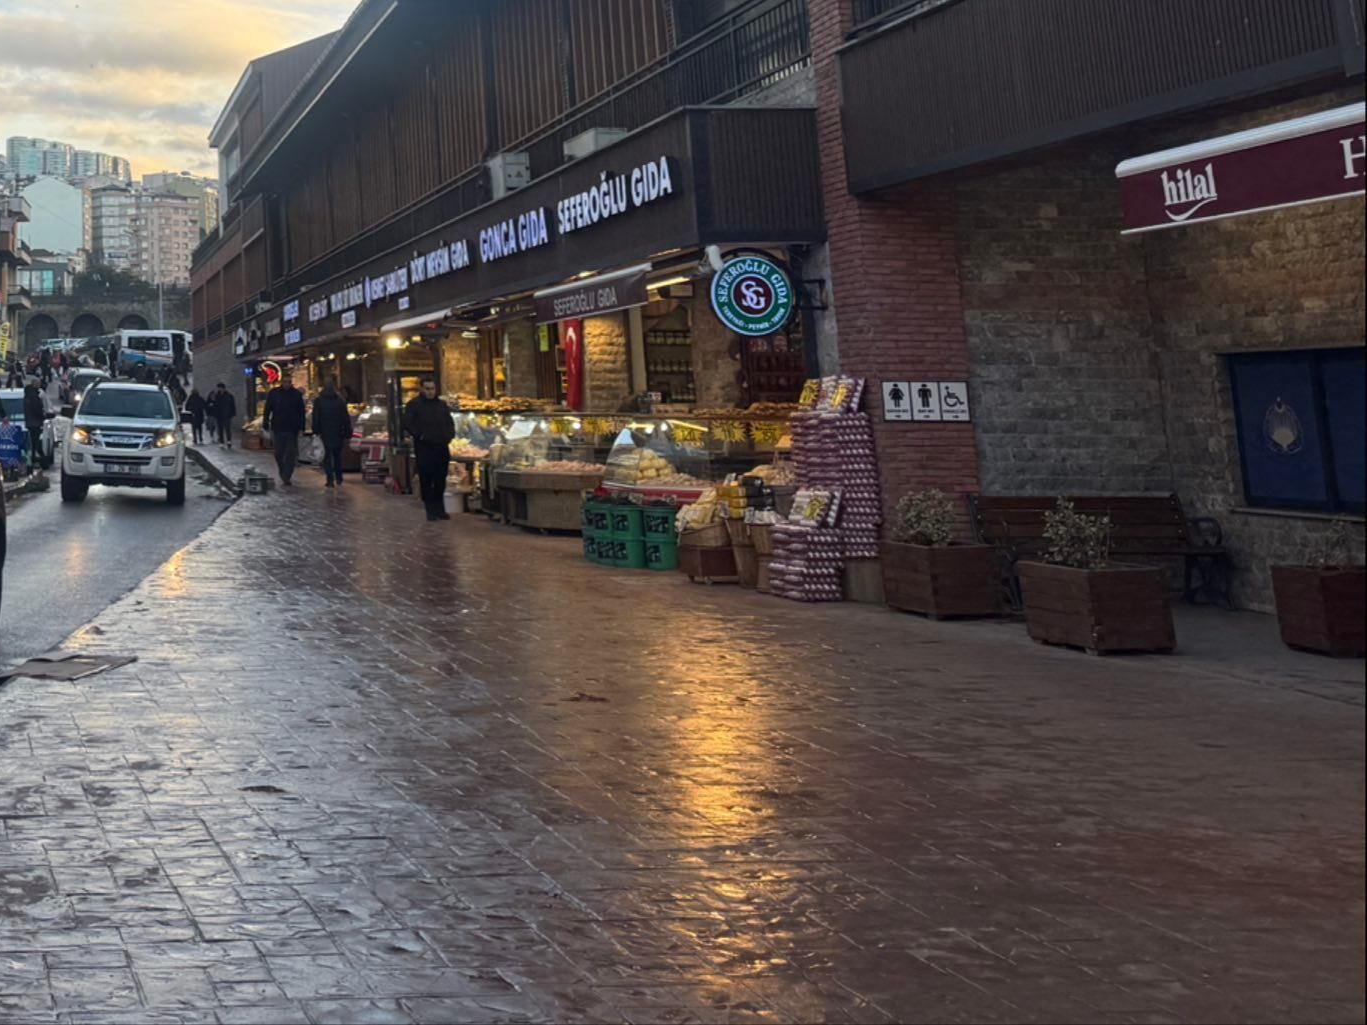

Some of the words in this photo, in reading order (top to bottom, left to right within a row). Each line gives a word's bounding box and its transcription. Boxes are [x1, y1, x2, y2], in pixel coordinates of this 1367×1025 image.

[557, 171, 627, 235] SEFEROĞLU
[631, 155, 673, 207] GIDA
[1161, 162, 1218, 206] hilal
[480, 219, 517, 263] GONCA
[518, 207, 549, 251] GIDA
[554, 289, 595, 317] SEFEROĞLU
[597, 287, 618, 307] GIDA
[718, 259, 770, 303] SEFEROĞLU
[771, 274, 788, 304] GIDA
[741, 281, 766, 309] SG
